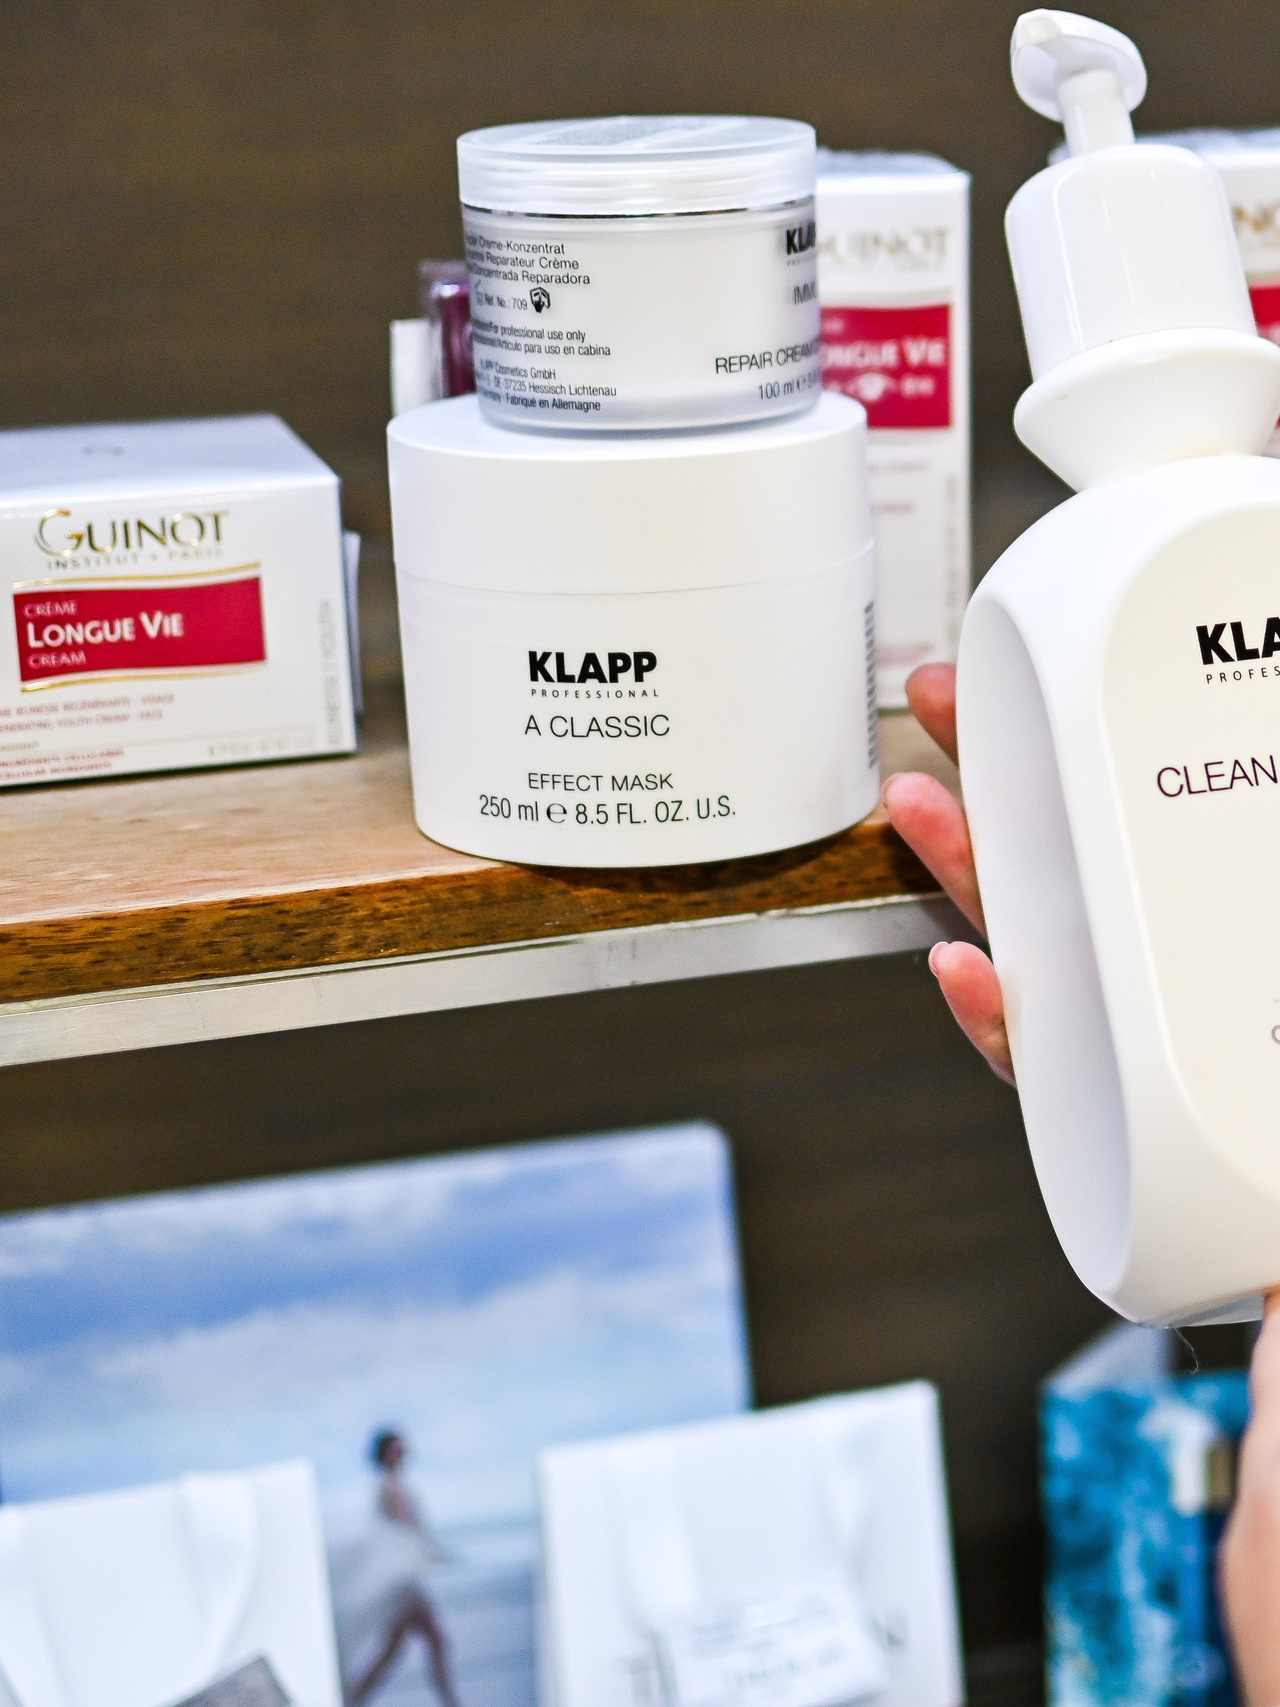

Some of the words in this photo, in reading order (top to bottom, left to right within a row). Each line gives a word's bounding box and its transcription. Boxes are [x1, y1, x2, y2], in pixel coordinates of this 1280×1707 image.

[539, 256, 579, 269] Crème
[521, 270, 590, 285] Reparadora
[512, 298, 528, 310] 709
[547, 330, 564, 341] use
[565, 330, 586, 343] only
[524, 343, 542, 354] para
[544, 345, 561, 354] uso
[563, 346, 576, 355] en
[578, 343, 611, 356] cabina
[495, 362, 528, 378] Cosmetics
[530, 367, 556, 379] GmbH
[715, 351, 773, 374] REPAIR
[504, 379, 527, 392] 37235
[528, 382, 566, 395] Hessisch
[568, 384, 617, 397] Lichtenau
[758, 381, 780, 400] 100
[783, 376, 795, 395] ml
[539, 399, 550, 408] en
[551, 398, 601, 413] Allemagne
[34, 508, 230, 557] GUINOT
[26, 616, 137, 649] LONGUE
[28, 650, 88, 670] CREAM
[528, 650, 658, 683] KLAPP
[531, 688, 659, 699] PROFESSIONAL
[524, 714, 541, 736] A
[550, 714, 670, 738] CLASSIC
[528, 772, 603, 792] EFFECT
[611, 772, 674, 791] MASK
[1156, 754, 1279, 798] CLEAN
[479, 794, 511, 819] 250
[518, 800, 539, 822] ml
[575, 803, 609, 825] 8.5
[616, 803, 647, 824] FL.
[655, 800, 690, 823] OZ.
[696, 795, 736, 819] U.S.
